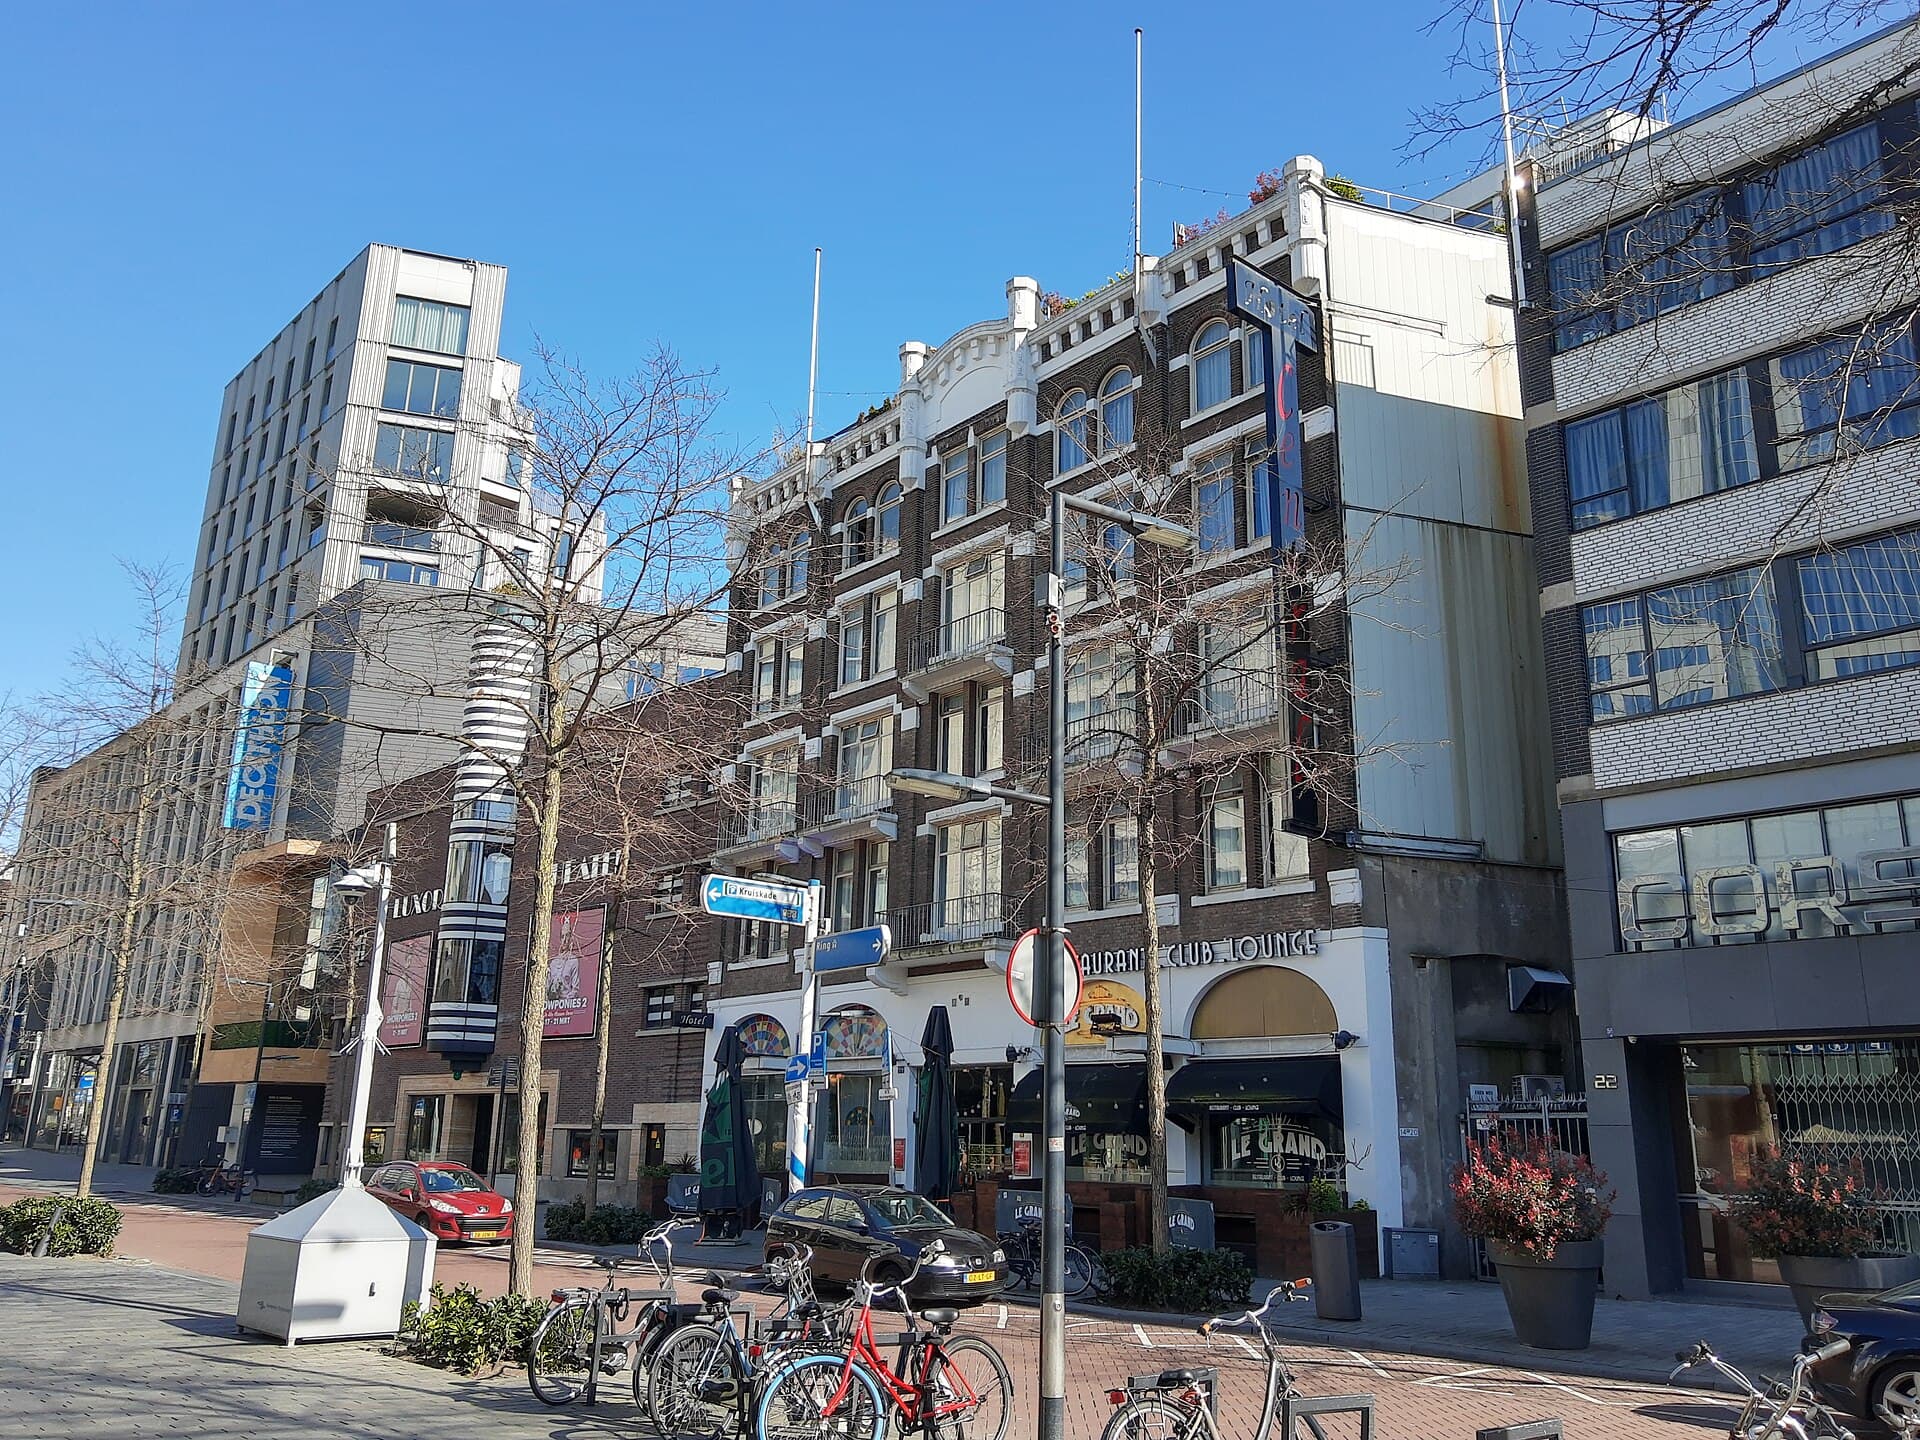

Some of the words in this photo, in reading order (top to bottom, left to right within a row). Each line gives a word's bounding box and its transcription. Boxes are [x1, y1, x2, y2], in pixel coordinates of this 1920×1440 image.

[236, 674, 282, 822] DECATHLON
[738, 886, 777, 900] Kruiskade
[816, 940, 831, 951] Ring
[1080, 947, 1146, 976] AURAN
[1168, 940, 1214, 967] CLUB
[1229, 929, 1318, 962] LOUNGE
[543, 998, 582, 1011] OWPONIES
[680, 1012, 706, 1026] Hotel
[1594, 1075, 1618, 1089] 22
[1071, 1134, 1087, 1156] LE
[1093, 1132, 1148, 1157] GRAND
[1231, 1135, 1251, 1162] LE
[1258, 1130, 1327, 1161] GRAND
[1014, 1207, 1023, 1219] LE
[1024, 1205, 1042, 1218] GRAN
[1168, 1214, 1176, 1228] LE
[1176, 1213, 1195, 1231] GRAND
